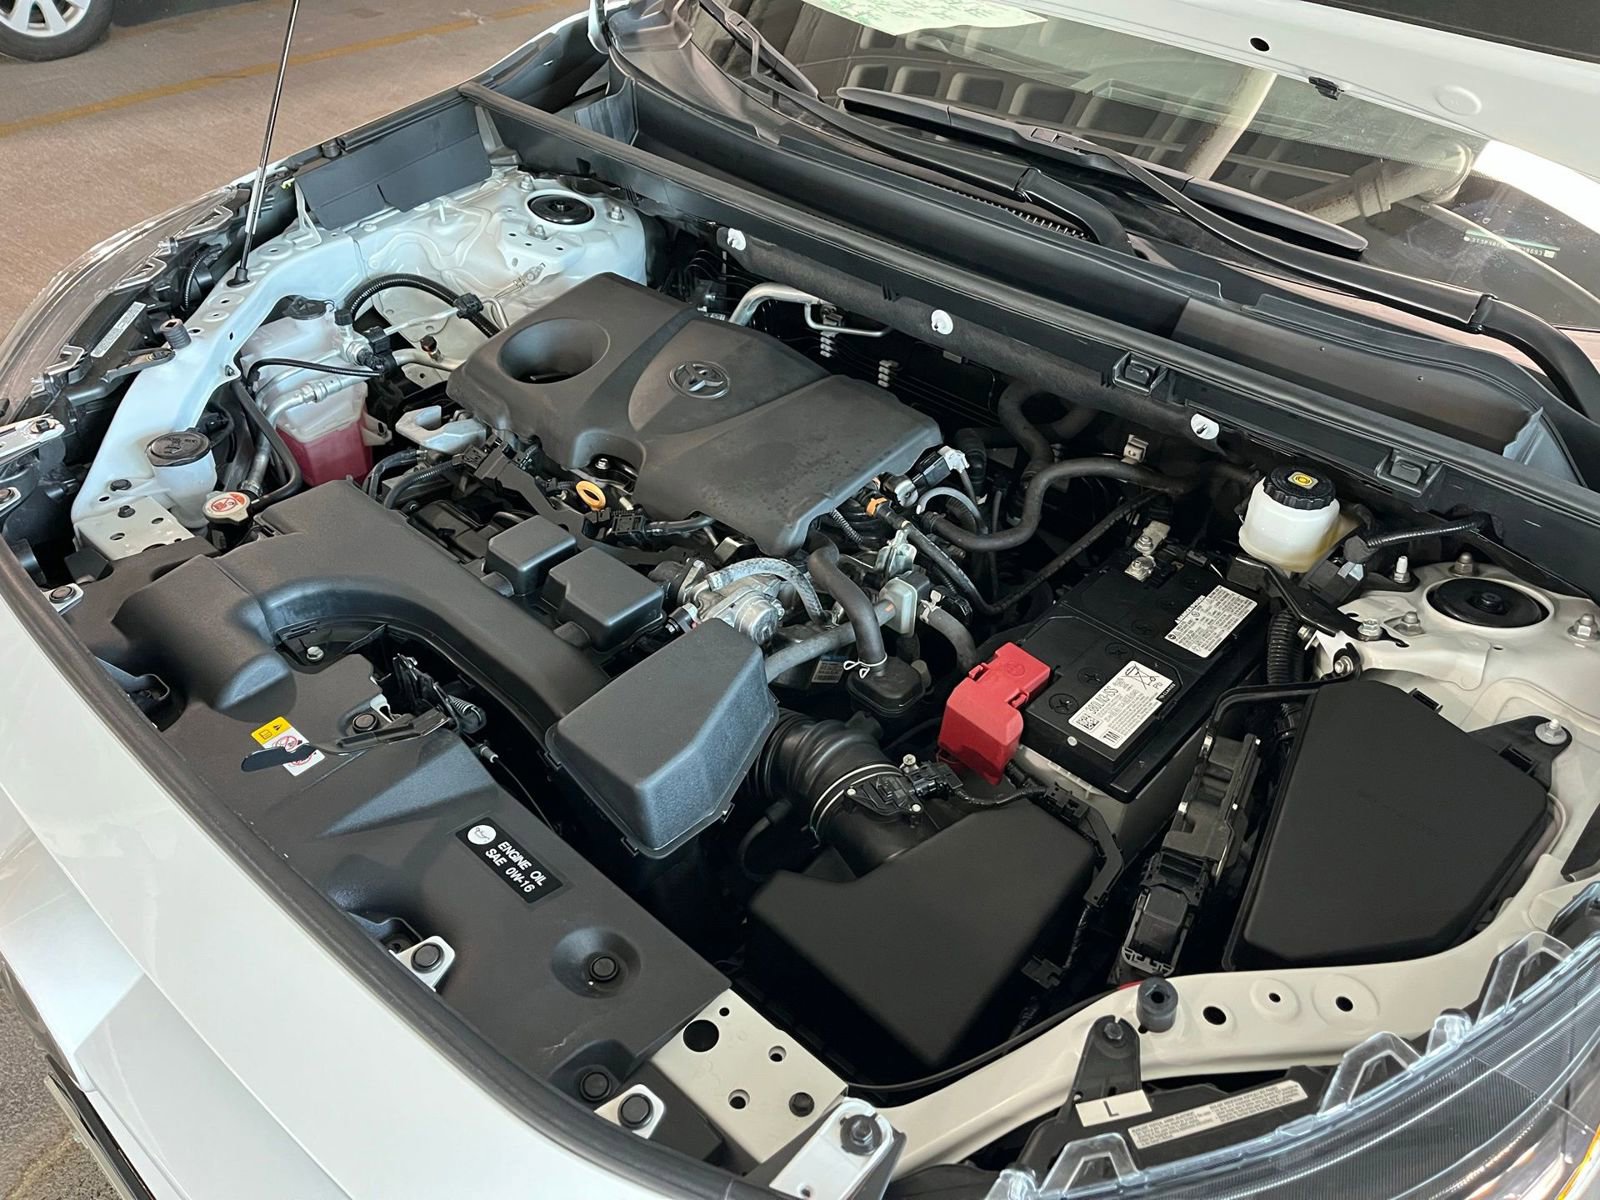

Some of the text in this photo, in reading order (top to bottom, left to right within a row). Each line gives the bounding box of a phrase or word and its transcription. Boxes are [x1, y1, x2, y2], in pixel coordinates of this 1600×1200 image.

[485, 848, 535, 893] SAE 0W-16
[498, 841, 547, 886] ENGINE OIL
[1103, 1100, 1119, 1117] L
